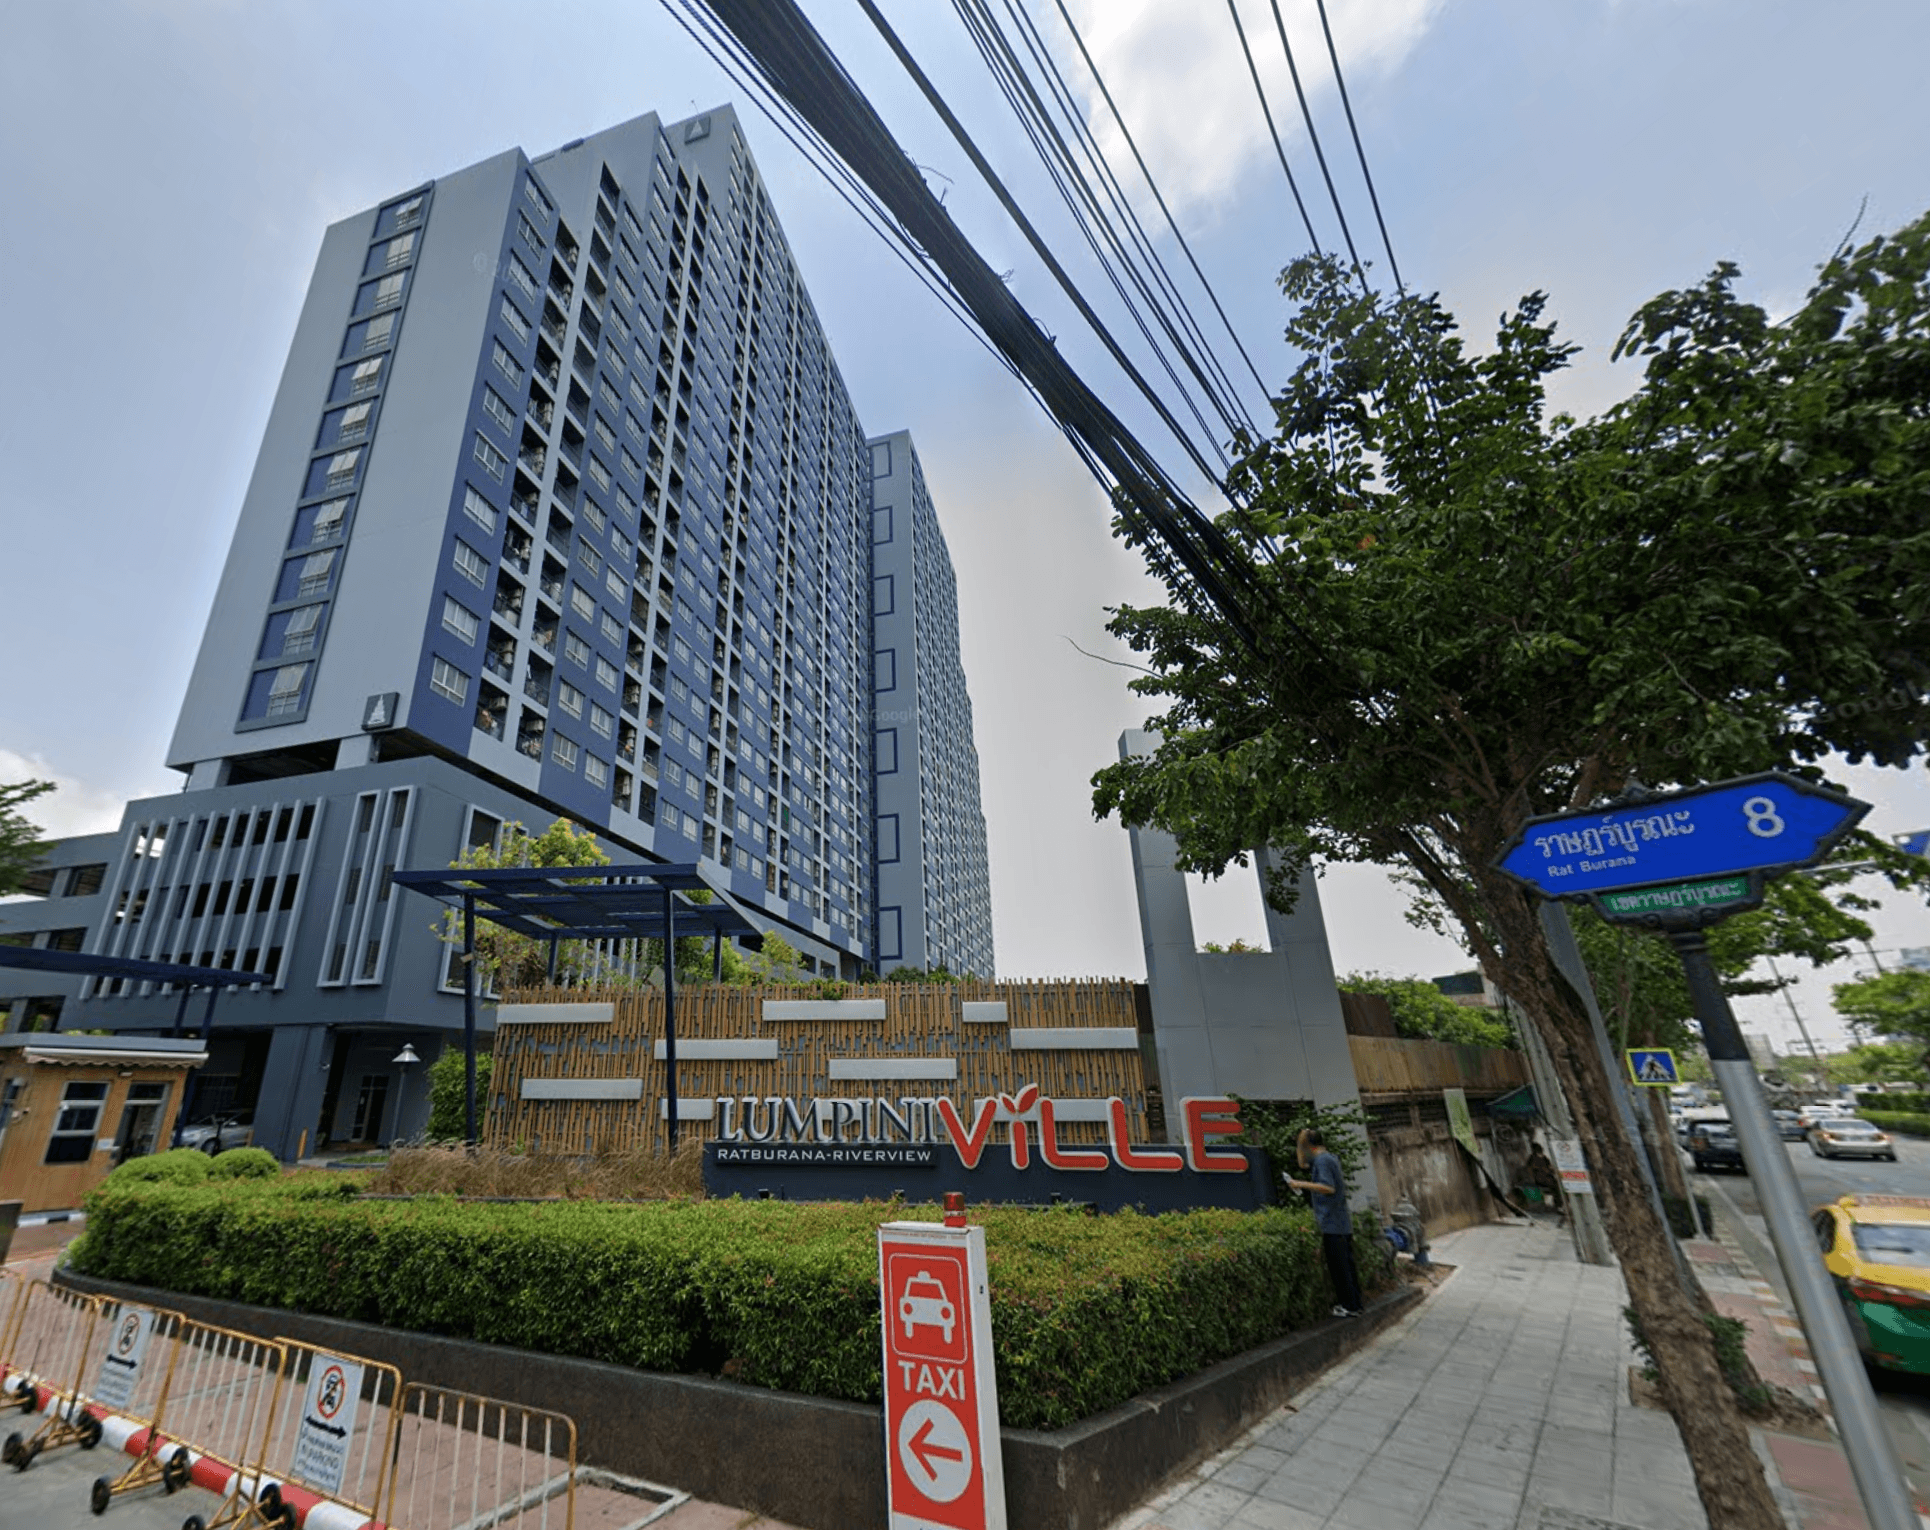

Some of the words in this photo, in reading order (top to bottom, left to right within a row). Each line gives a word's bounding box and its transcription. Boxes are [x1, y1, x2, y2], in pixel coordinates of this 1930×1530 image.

[1534, 810, 1695, 858] ราษฎร์บูรณะ
[1742, 796, 1786, 838] 8
[1547, 863, 1574, 877] Rat
[1579, 855, 1637, 872] Burana
[715, 1096, 938, 1143] LUMPINI
[717, 1148, 932, 1162] RATBURANA-RIVERVIEW
[898, 1360, 966, 1400] TAXI
